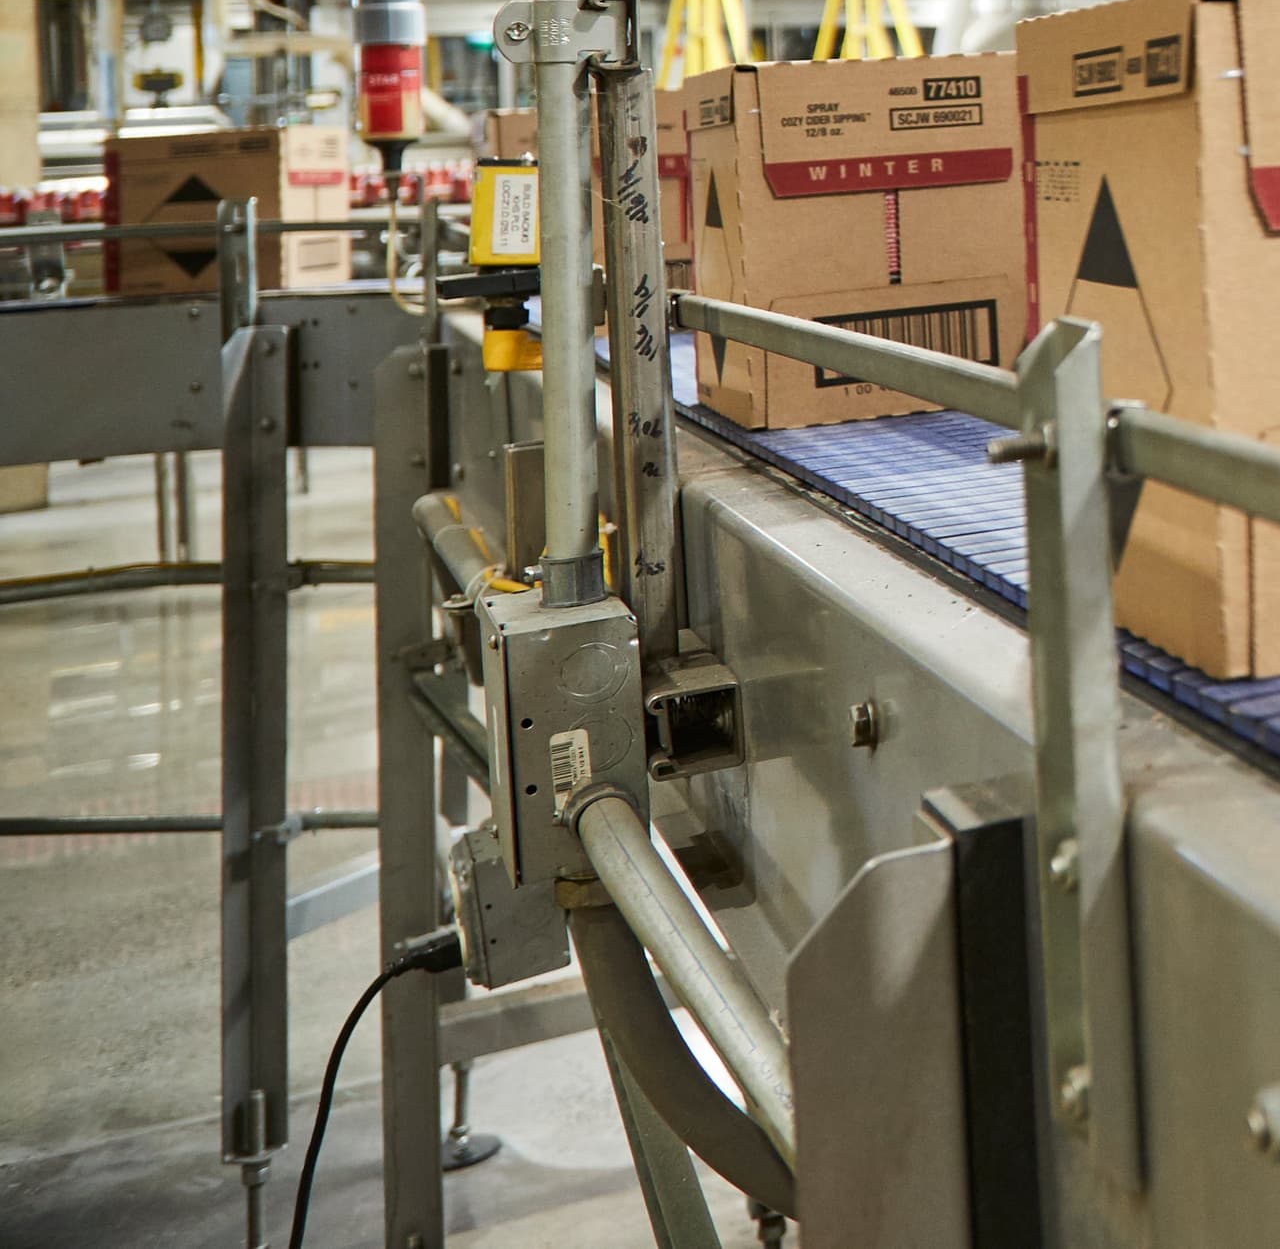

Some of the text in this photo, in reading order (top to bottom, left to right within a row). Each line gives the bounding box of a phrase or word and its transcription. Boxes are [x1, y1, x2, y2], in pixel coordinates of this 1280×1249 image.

[926, 79, 977, 98] 77410
[806, 103, 840, 114] SPRAY
[781, 116, 804, 127] COZY
[806, 115, 831, 126] CIDER
[897, 110, 973, 126] SCJW 690021
[805, 127, 844, 138] 12/8 oz.
[808, 157, 944, 181] WINTER
